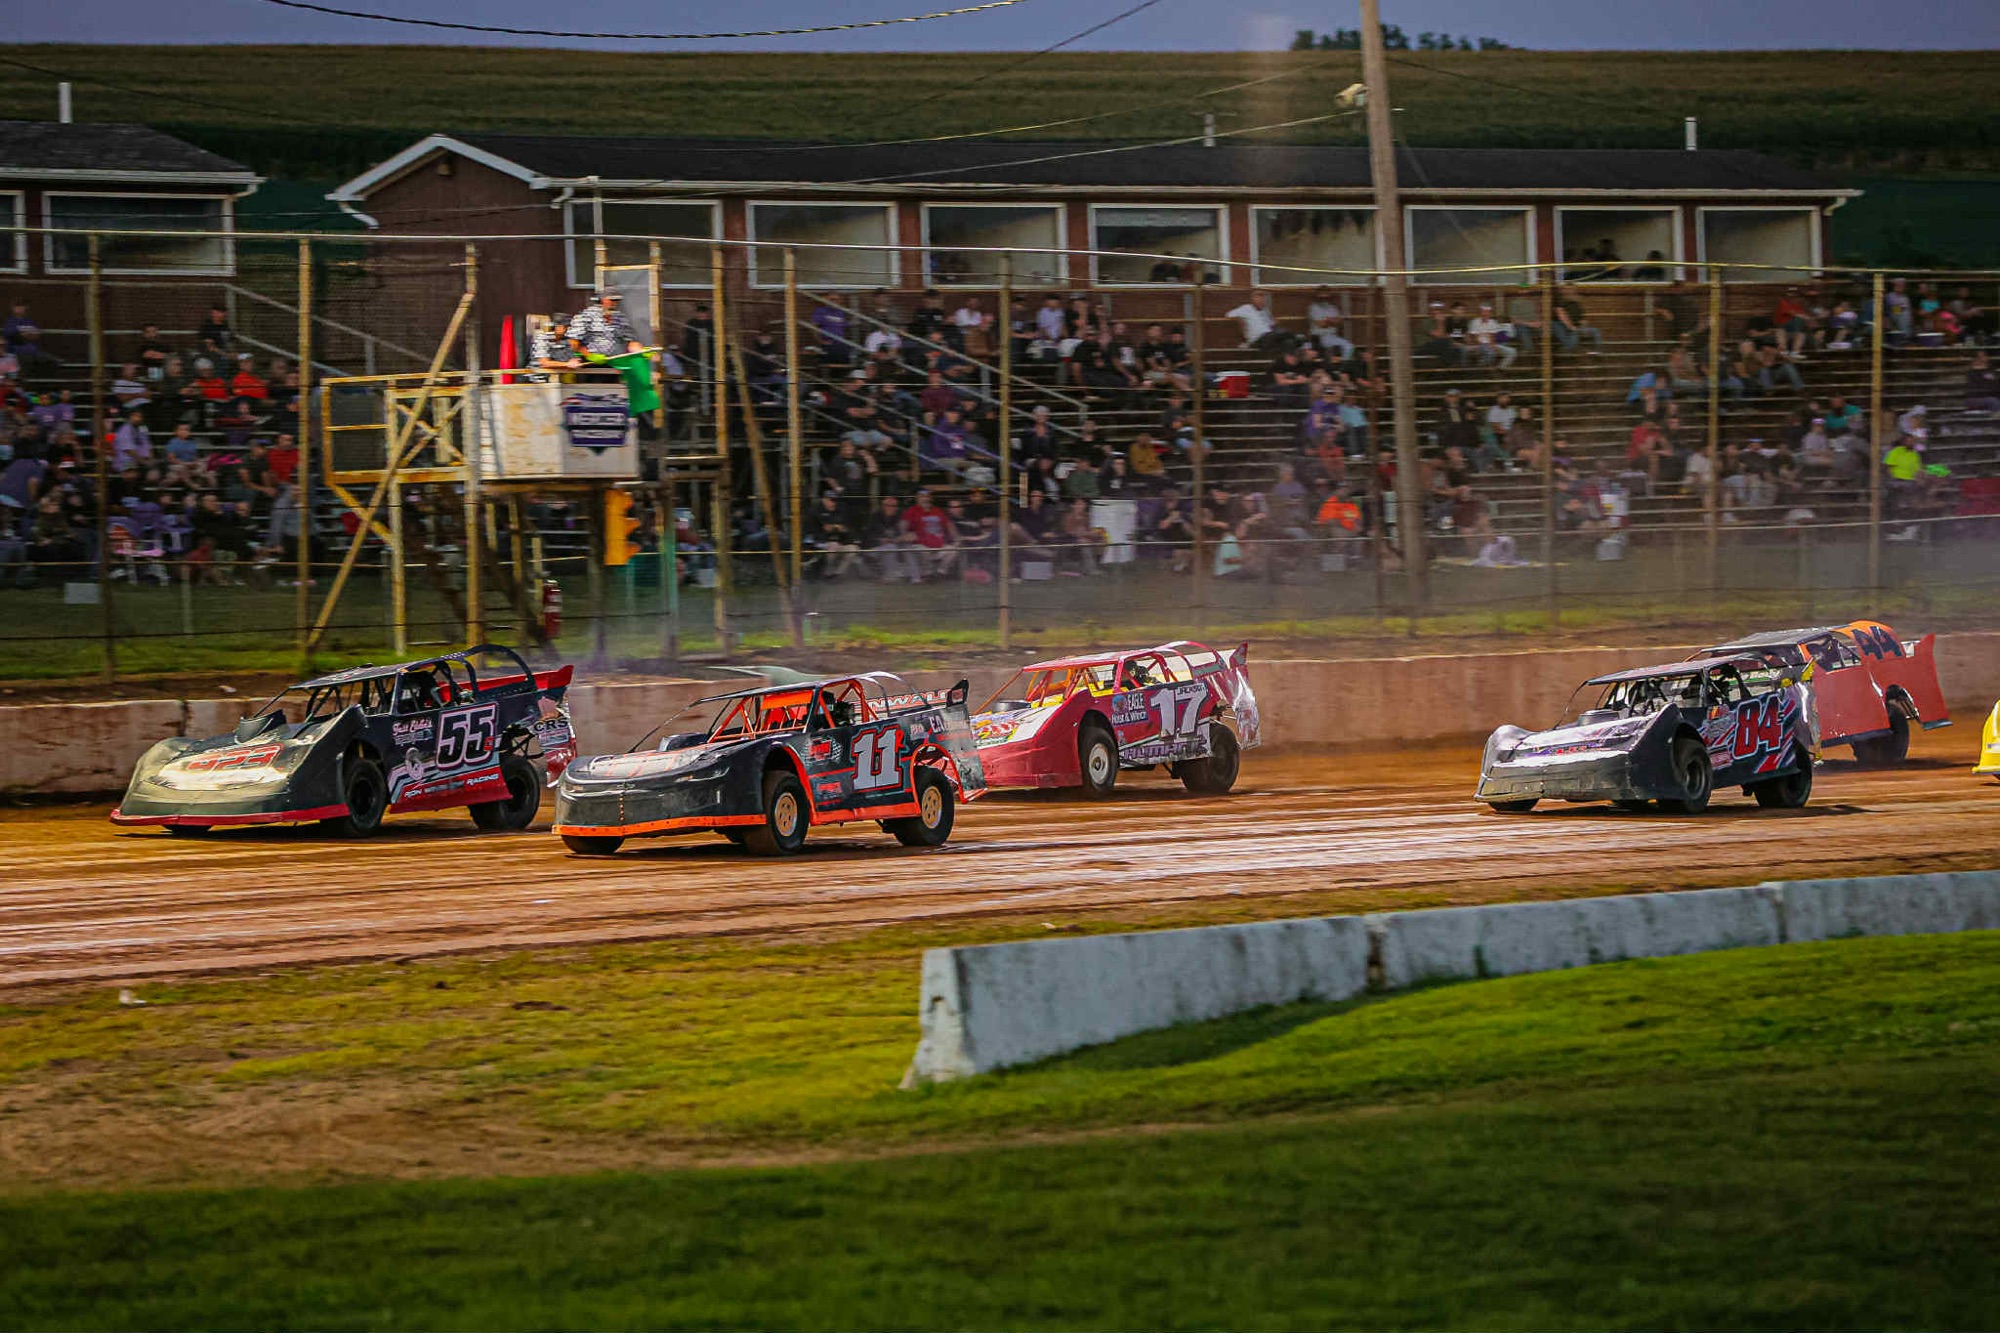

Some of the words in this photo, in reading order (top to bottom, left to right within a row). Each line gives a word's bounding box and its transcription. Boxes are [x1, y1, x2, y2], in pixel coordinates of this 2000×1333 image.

[1851, 626, 1902, 660] 44
[436, 704, 497, 768] 55
[533, 717, 568, 731] CRS
[1151, 683, 1207, 738] 17
[1733, 693, 1783, 759] 84
[466, 773, 499, 786] RACING
[852, 725, 902, 792] 11
